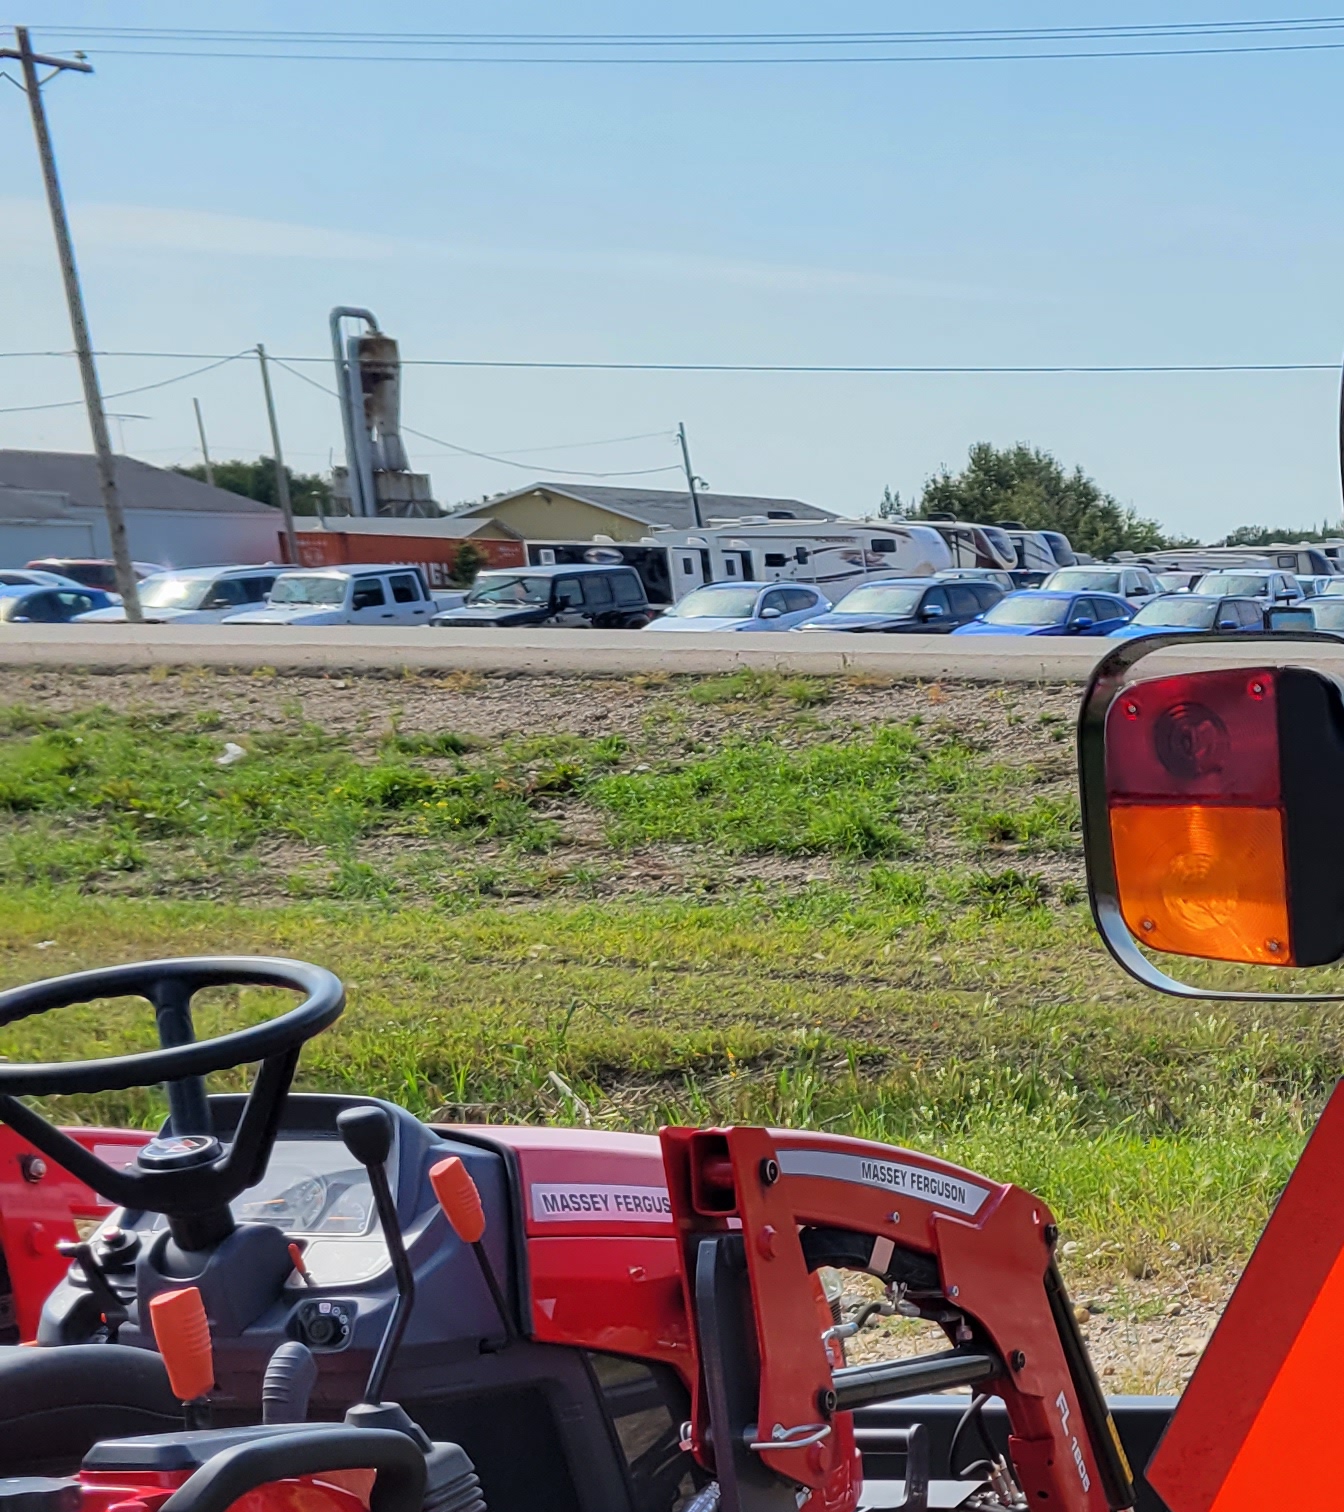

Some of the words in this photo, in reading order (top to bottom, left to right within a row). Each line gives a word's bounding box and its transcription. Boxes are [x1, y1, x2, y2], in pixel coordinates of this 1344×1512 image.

[541, 1193, 609, 1212] MASSEY
[613, 1194, 672, 1213] FERGUS
[861, 1161, 907, 1187] MASSEY
[910, 1172, 966, 1204] FERGUSON
[1055, 1390, 1070, 1438] FL
